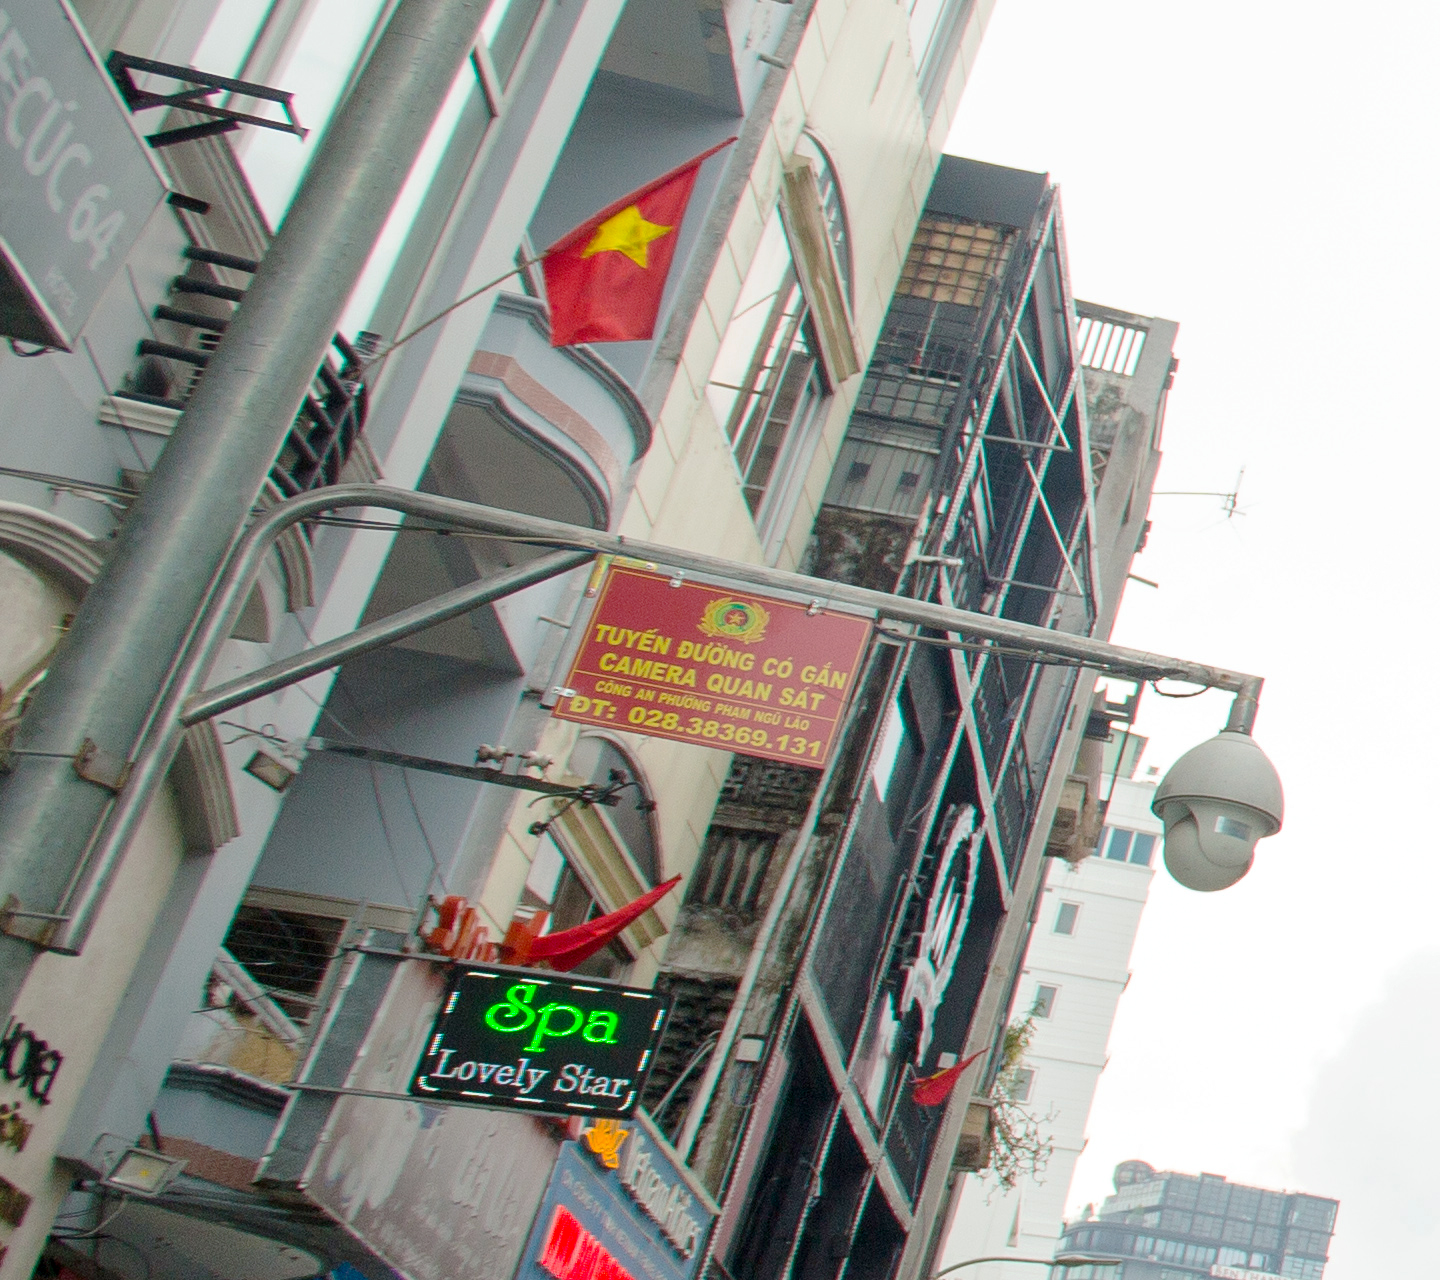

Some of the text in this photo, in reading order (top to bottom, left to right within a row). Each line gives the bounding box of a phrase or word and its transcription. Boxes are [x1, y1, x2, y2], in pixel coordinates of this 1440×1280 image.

[68, 183, 126, 273] 64
[596, 623, 849, 689] TUYẾN ĐƯỜNG CÓ GẮN
[600, 652, 825, 711] CAMERA QUAN SÁT
[595, 679, 633, 699] CÔNG
[635, 688, 655, 702] AN
[569, 695, 821, 758] ĐT: 028.38369.131
[485, 984, 618, 1053] Spa
[430, 1048, 632, 1098] Lovely Star
